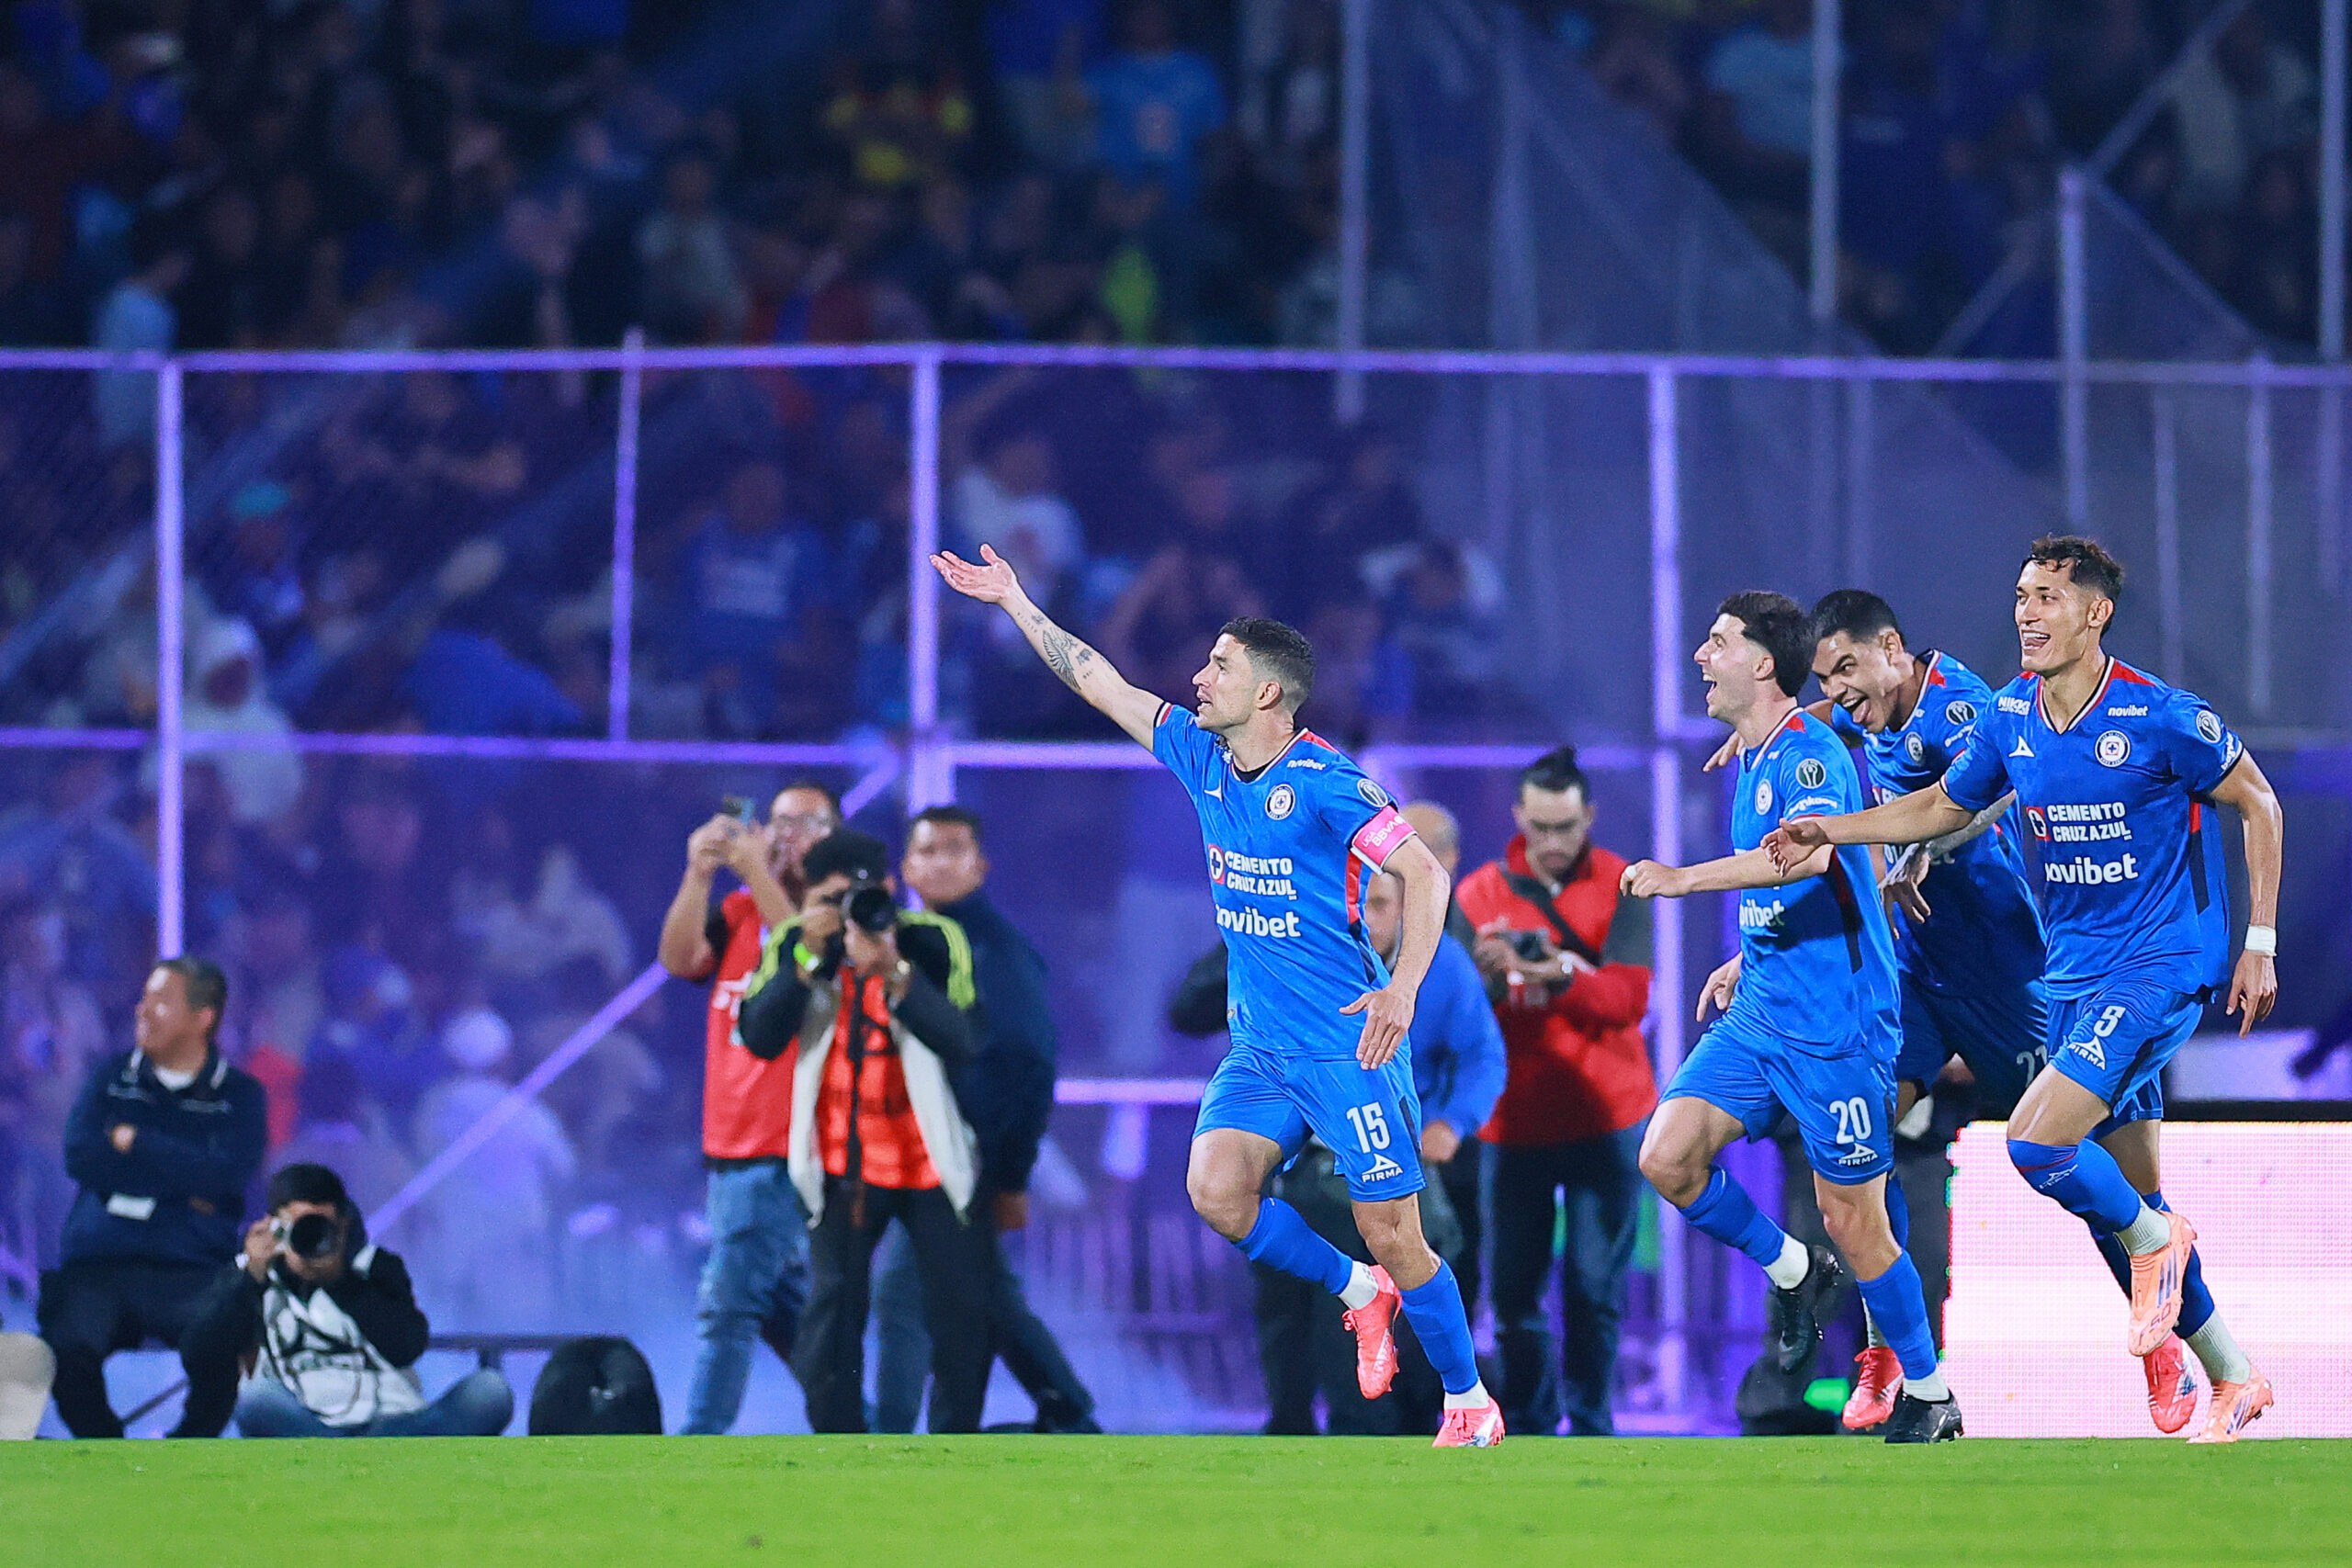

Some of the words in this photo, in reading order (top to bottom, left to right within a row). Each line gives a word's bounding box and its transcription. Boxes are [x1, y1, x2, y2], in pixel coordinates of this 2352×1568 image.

[2108, 705, 2148, 716] novibet
[2047, 802, 2126, 822] CEMENTO
[1372, 820, 1398, 847] BBVA
[2052, 825, 2088, 842] CRUZ
[2089, 820, 2132, 840] AZUL
[1225, 851, 1294, 875] CEMENTO
[1227, 872, 1257, 894] CRUZ
[1257, 878, 1297, 896] AZUL
[2093, 1005, 2126, 1037] 5
[2066, 1043, 2106, 1070] PIRMA
[1346, 1101, 1391, 1154] 15
[1829, 1097, 1871, 1145] 20
[1838, 1153, 1879, 1166] PIRMA
[1362, 1167, 1404, 1183] PIRMA
